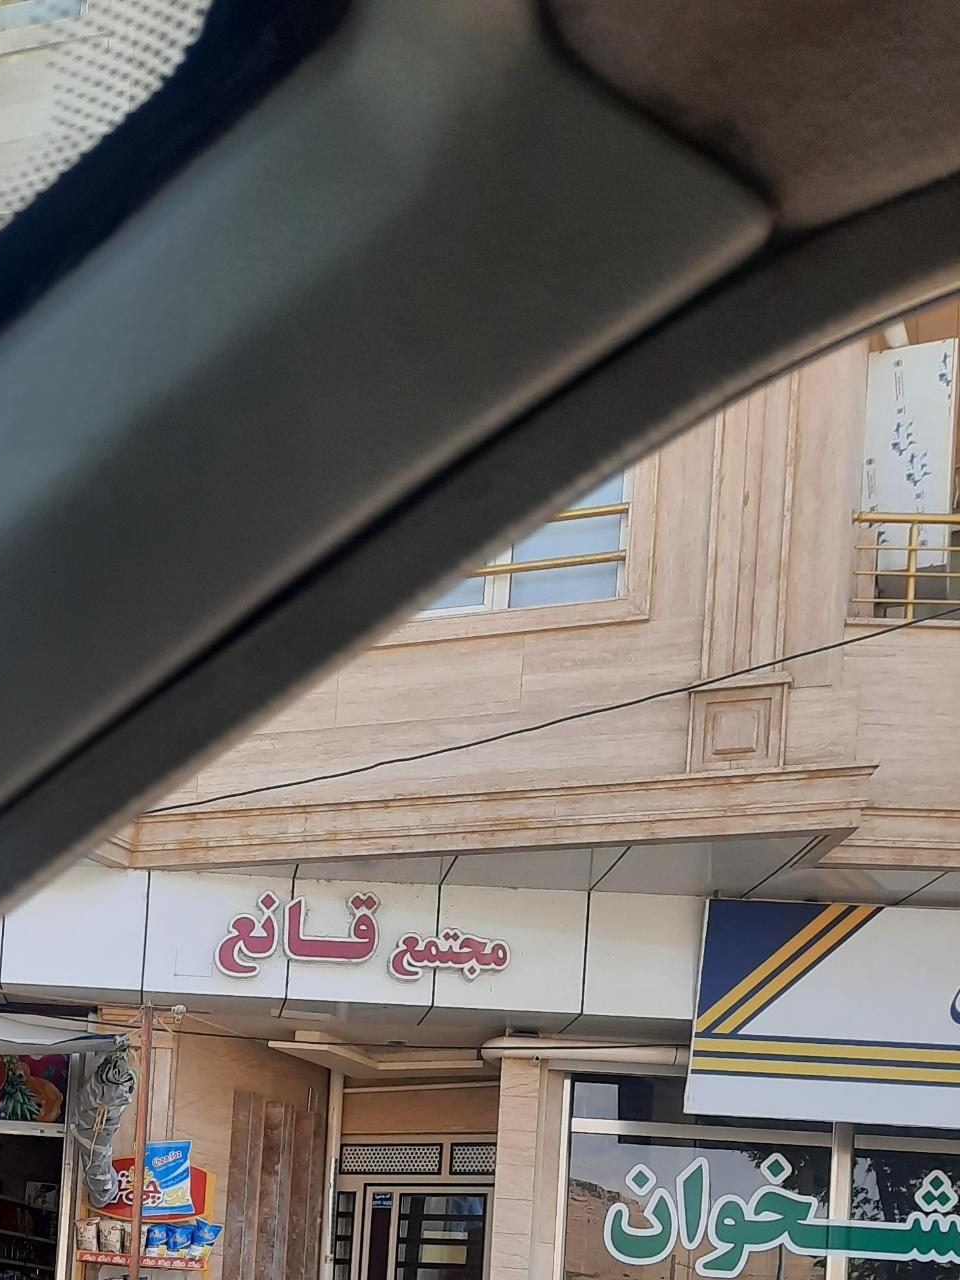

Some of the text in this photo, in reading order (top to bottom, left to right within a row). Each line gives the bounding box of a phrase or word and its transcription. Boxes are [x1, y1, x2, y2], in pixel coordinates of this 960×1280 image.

[216, 890, 510, 980] مجتمع قانع
[606, 1154, 960, 1277] شخوان
